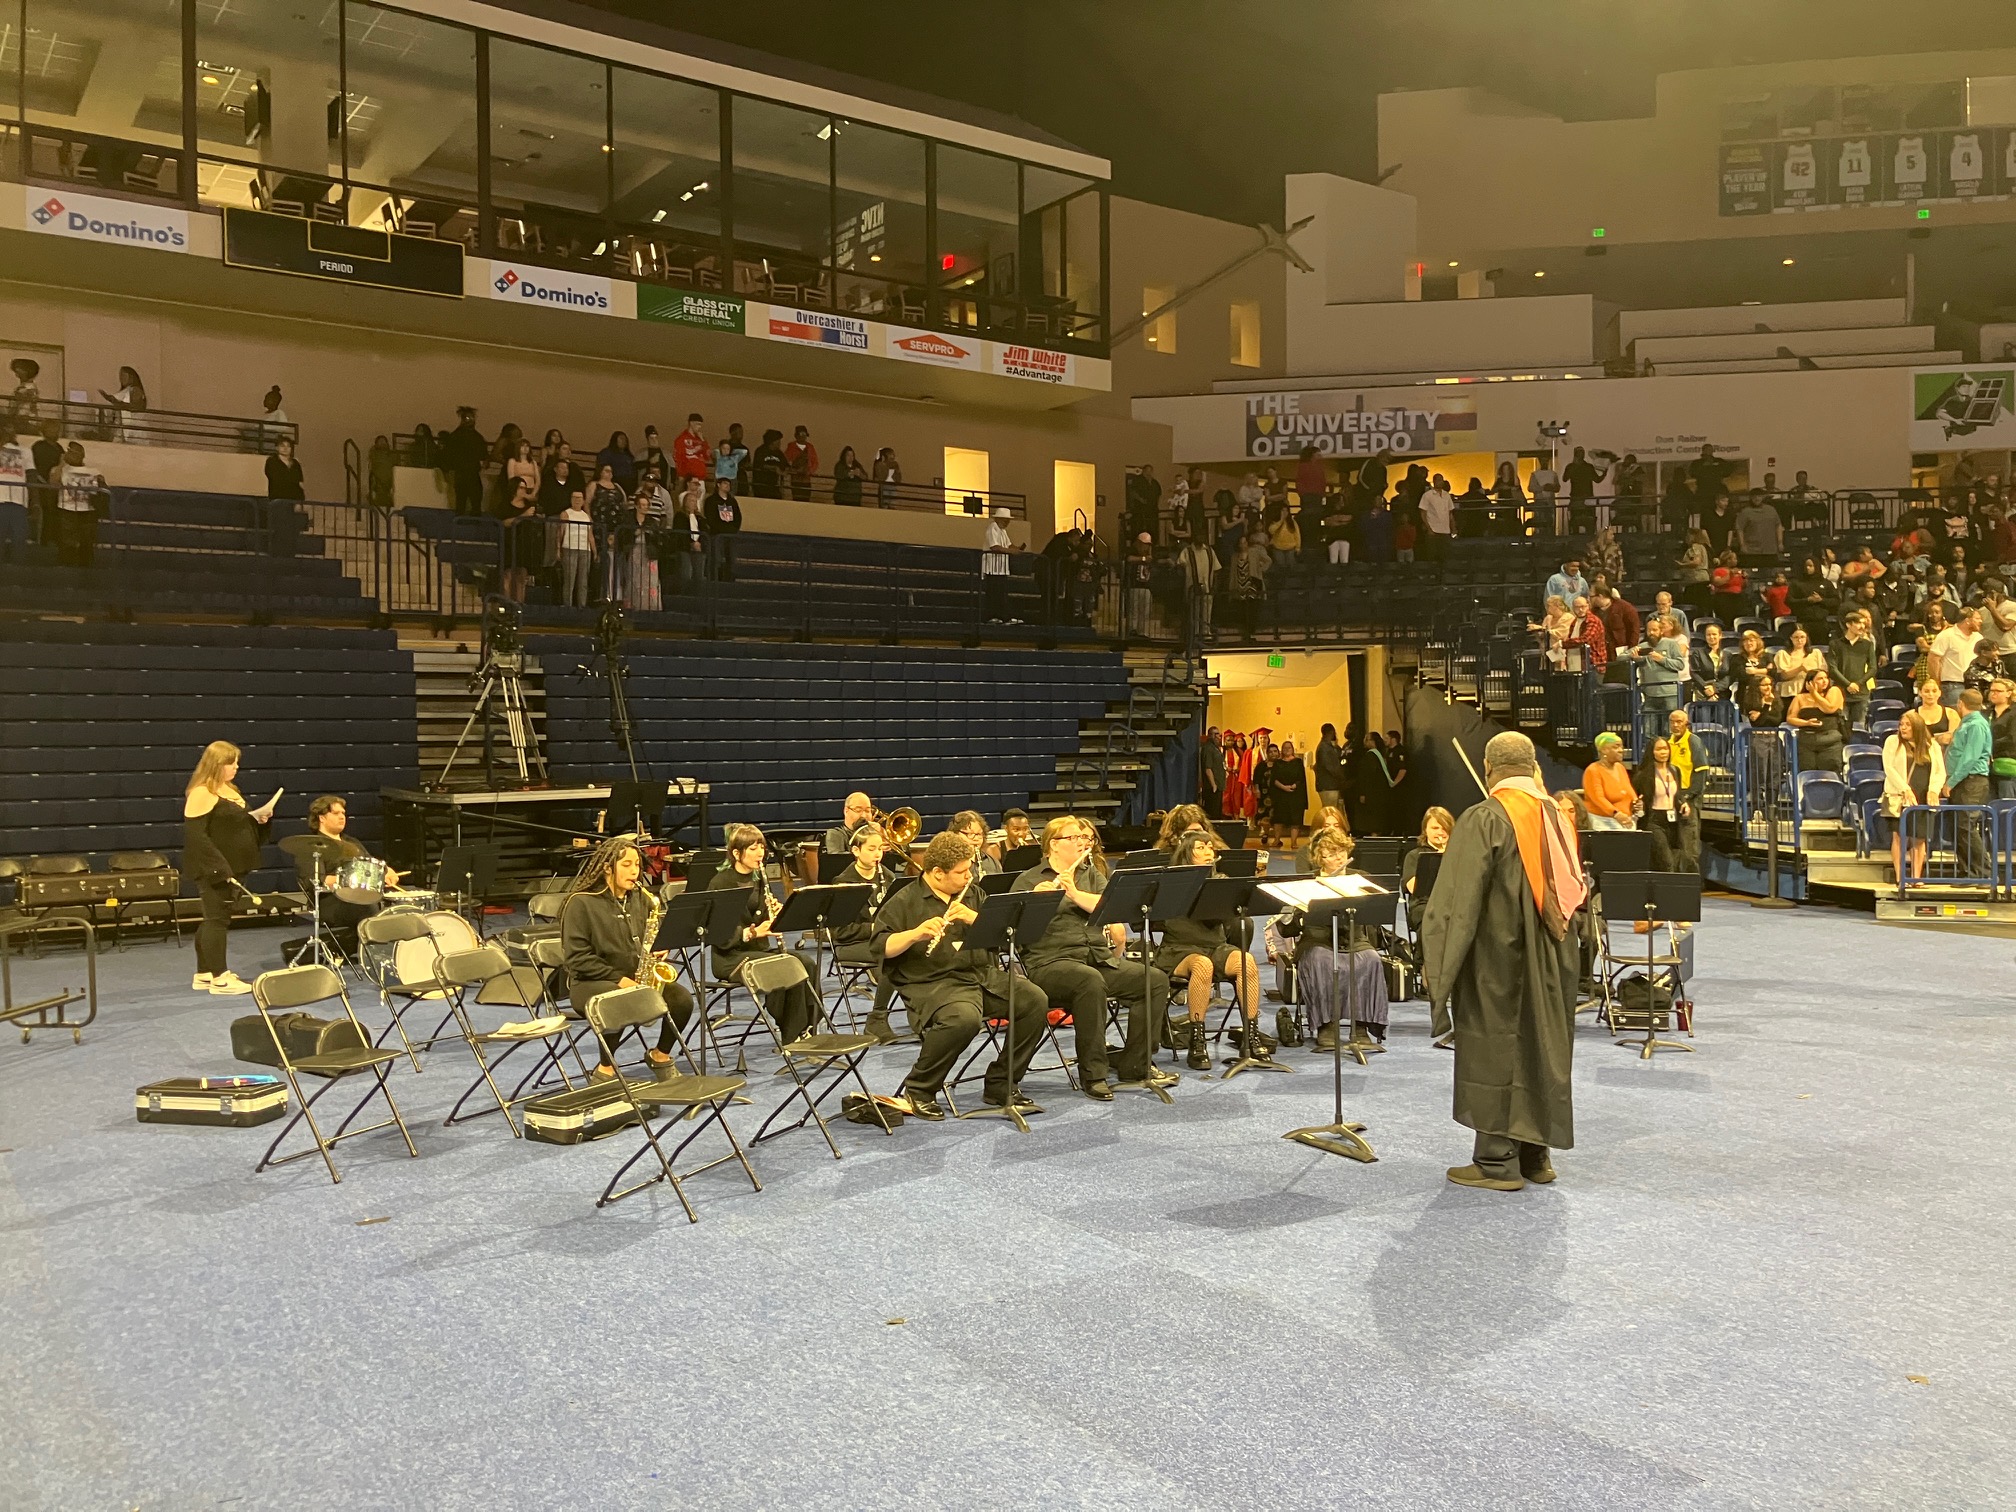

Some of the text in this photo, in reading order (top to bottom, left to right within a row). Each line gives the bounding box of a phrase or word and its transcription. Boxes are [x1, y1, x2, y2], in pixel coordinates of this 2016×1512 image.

[1791, 162, 1810, 176] 42
[68, 211, 184, 246] Domino's
[319, 260, 354, 274] PERIOD
[521, 281, 608, 308] Domino's
[683, 296, 742, 313] GLASS CITY
[683, 304, 731, 320] FEDERAL
[682, 314, 736, 327] CREDIT UNION
[796, 311, 855, 331] Overcashier
[858, 322, 864, 332] &
[839, 331, 866, 347] Horst
[909, 340, 955, 355] SERVPRO
[1003, 346, 1066, 366] Jim White
[1006, 366, 1062, 383] #Advantage
[1247, 394, 1299, 416] THE
[1276, 410, 1440, 435] UNIVERSITY
[1252, 431, 1412, 457] OF TOLEDO
